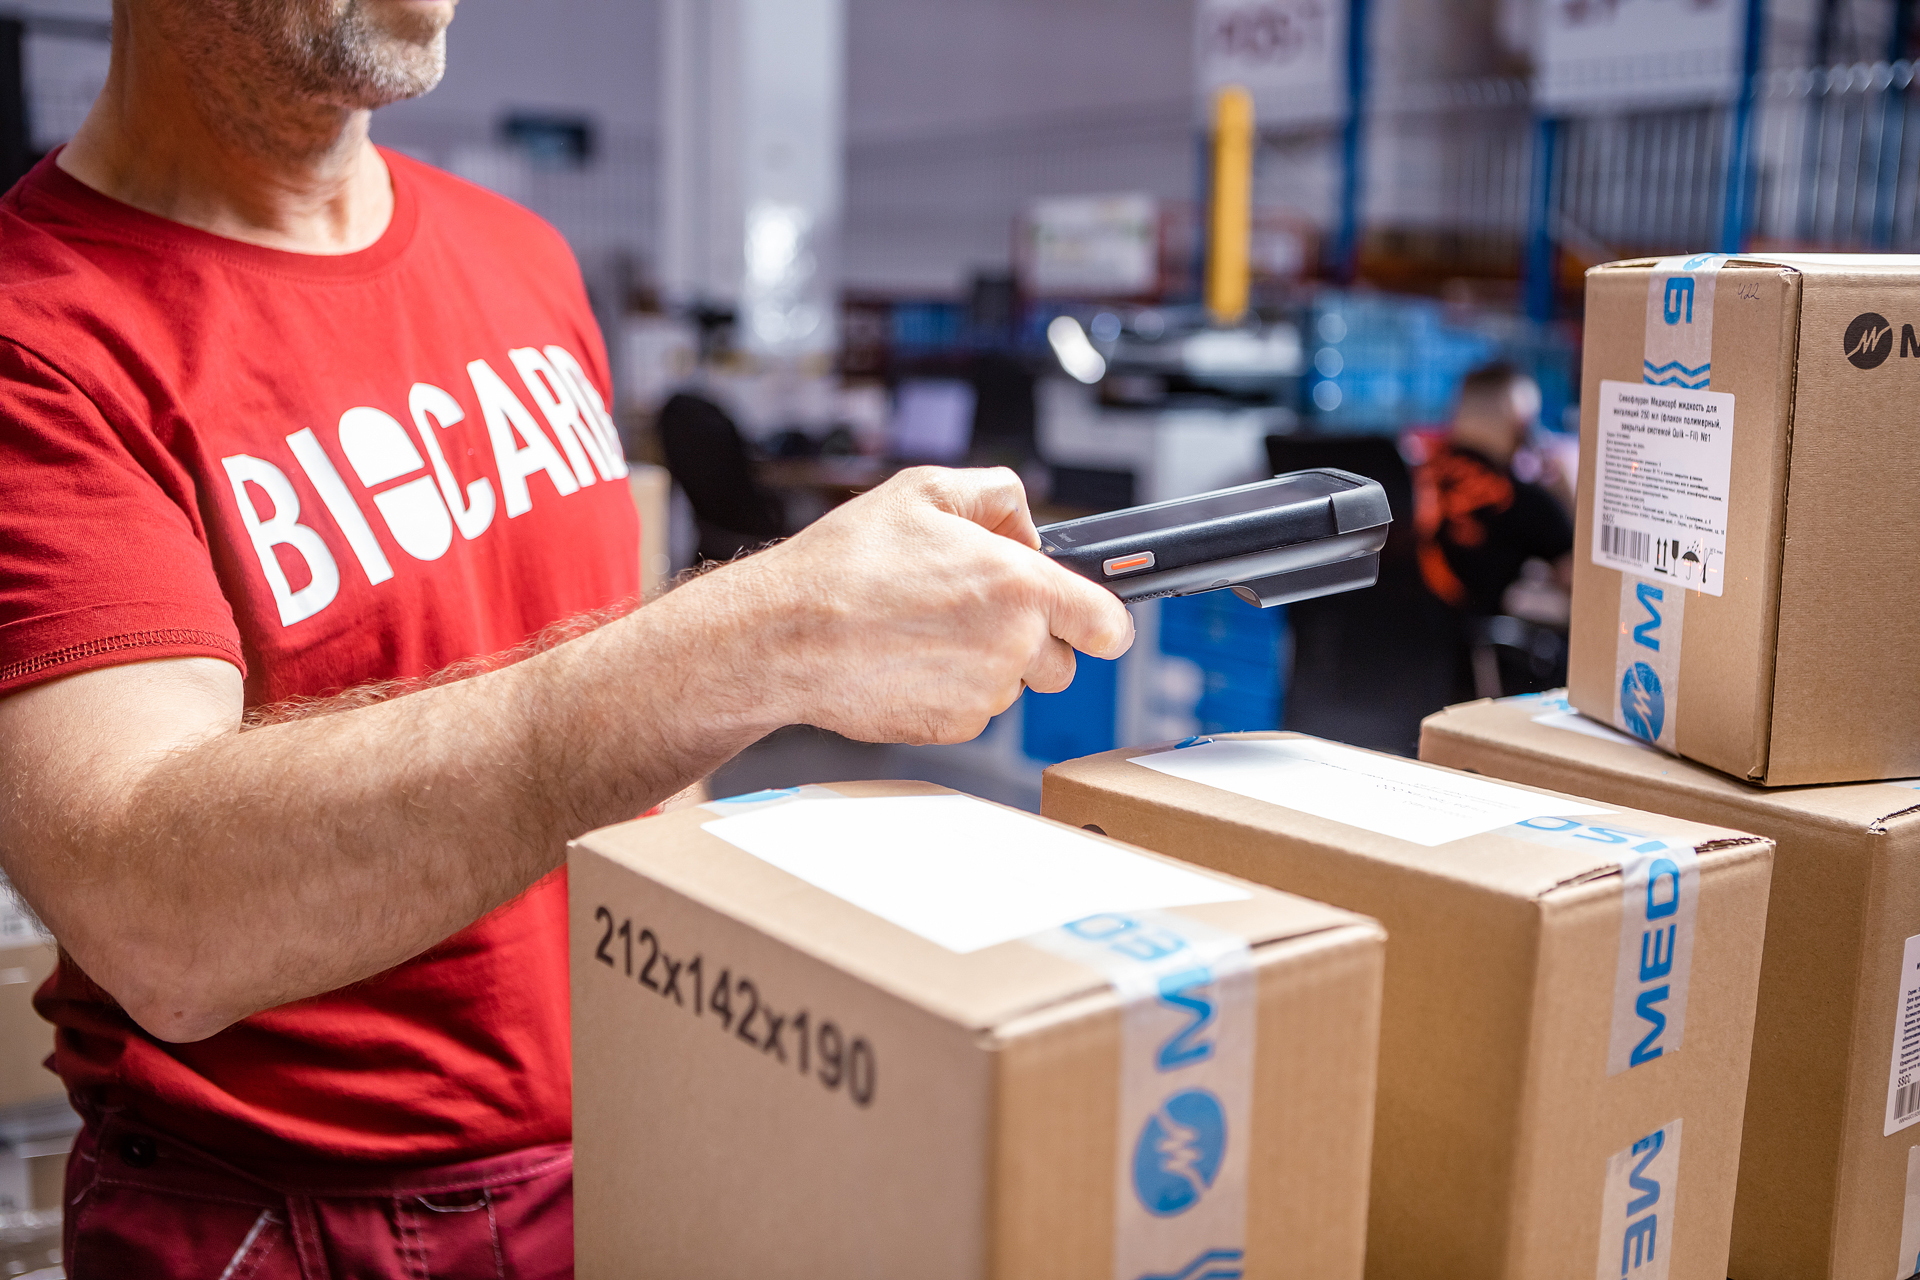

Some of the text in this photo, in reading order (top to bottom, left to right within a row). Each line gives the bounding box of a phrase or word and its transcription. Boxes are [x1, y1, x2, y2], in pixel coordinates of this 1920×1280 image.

[1650, 396, 1677, 409] Медисорб
[1678, 401, 1704, 412] жидкость
[1705, 404, 1718, 413] для
[1683, 417, 1722, 430] полимерный,
[593, 906, 878, 1109] 212x142x190
